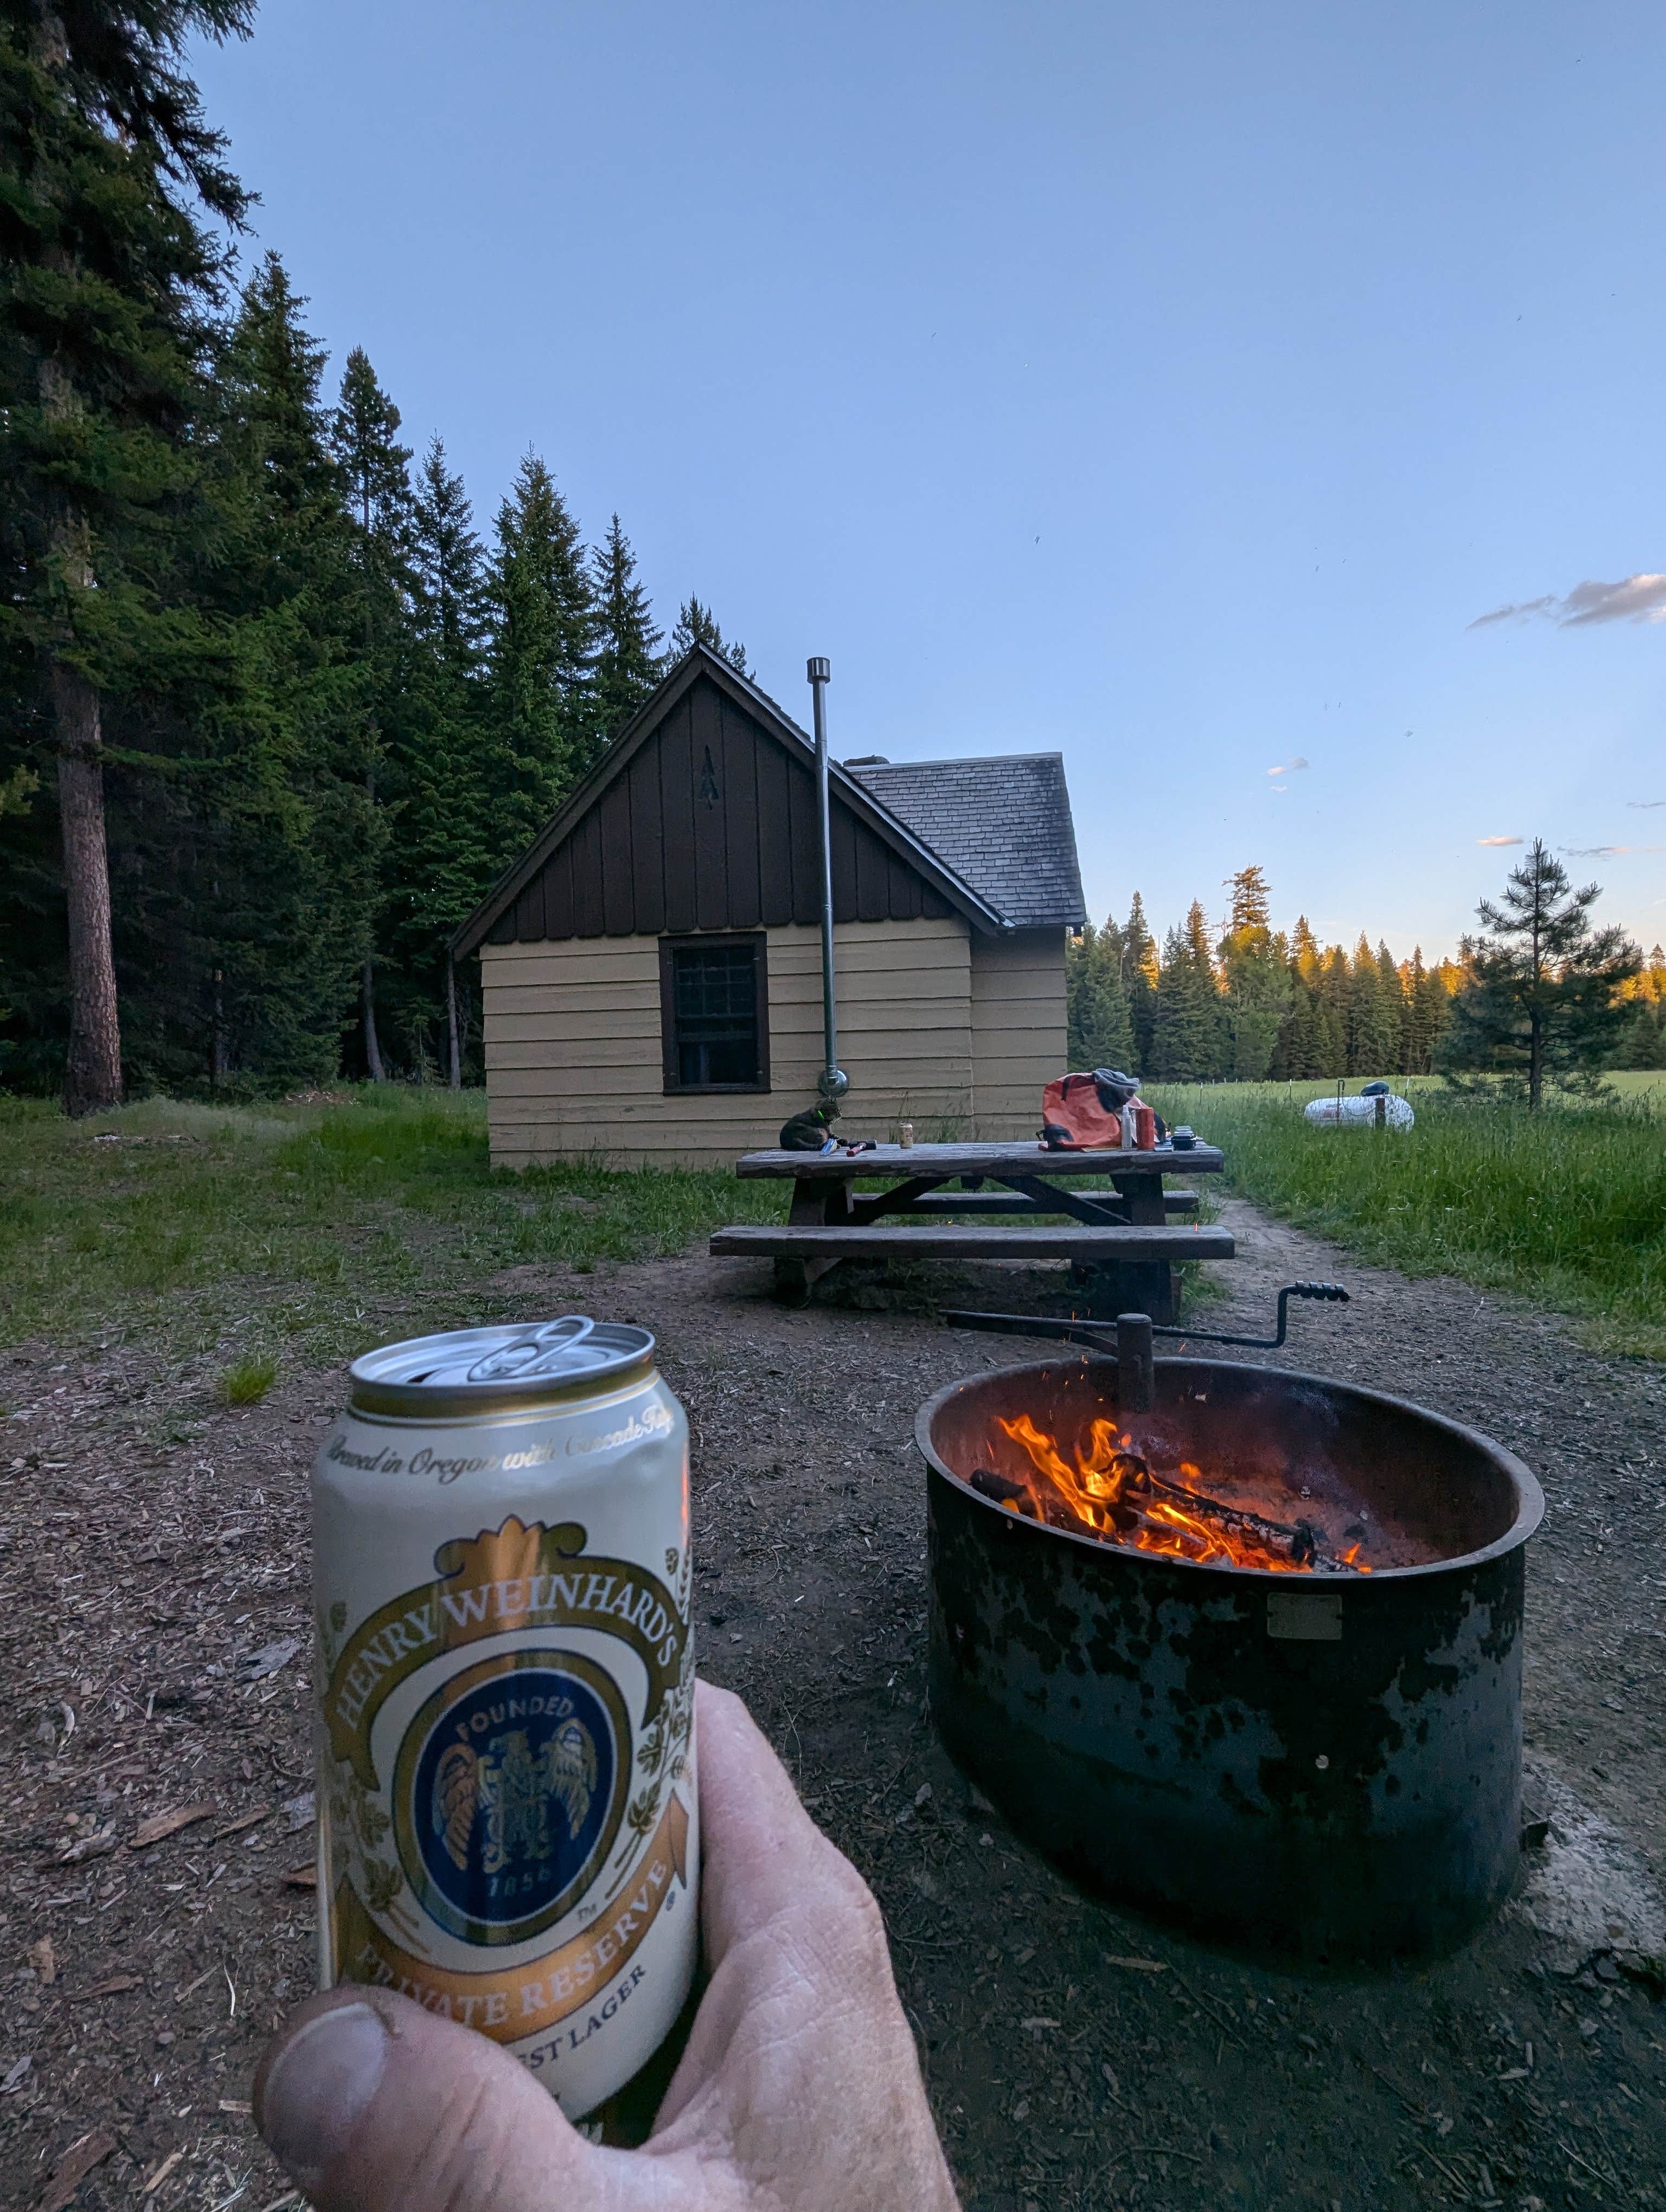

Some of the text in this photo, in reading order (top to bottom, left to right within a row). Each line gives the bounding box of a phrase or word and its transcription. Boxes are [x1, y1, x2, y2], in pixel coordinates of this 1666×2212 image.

[381, 1451, 403, 1474] in
[408, 1446, 499, 1486] Oregon
[501, 1437, 556, 1471] with
[336, 1573, 677, 1732] HENRY WEINHARD'S
[454, 1695, 575, 1743] FOUNDED
[520, 1859, 668, 2016] RESERVE
[568, 1964, 647, 2049] LAGER
